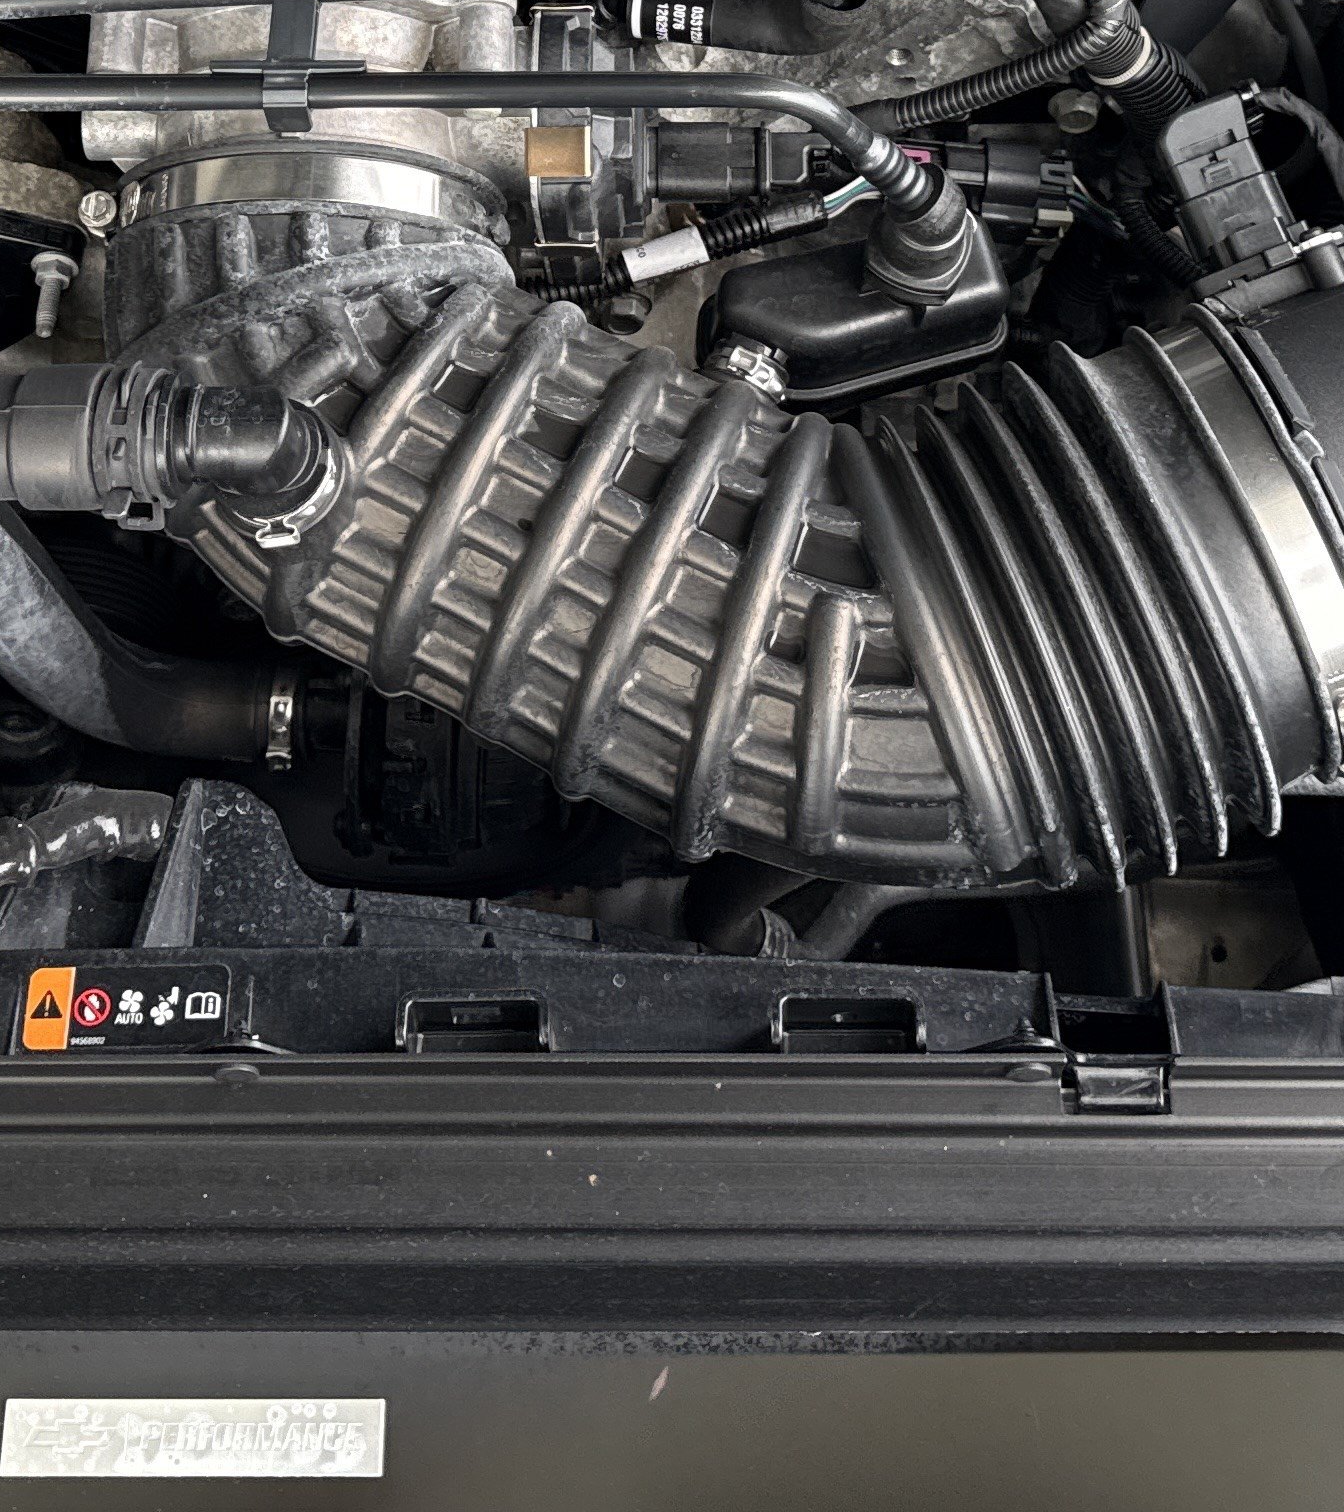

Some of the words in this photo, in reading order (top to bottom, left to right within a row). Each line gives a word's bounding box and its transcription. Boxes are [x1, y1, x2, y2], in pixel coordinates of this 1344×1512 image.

[672, 3, 687, 31] 0076
[114, 1011, 144, 1025] AUTO
[138, 1421, 363, 1452] PERFORMANCE
